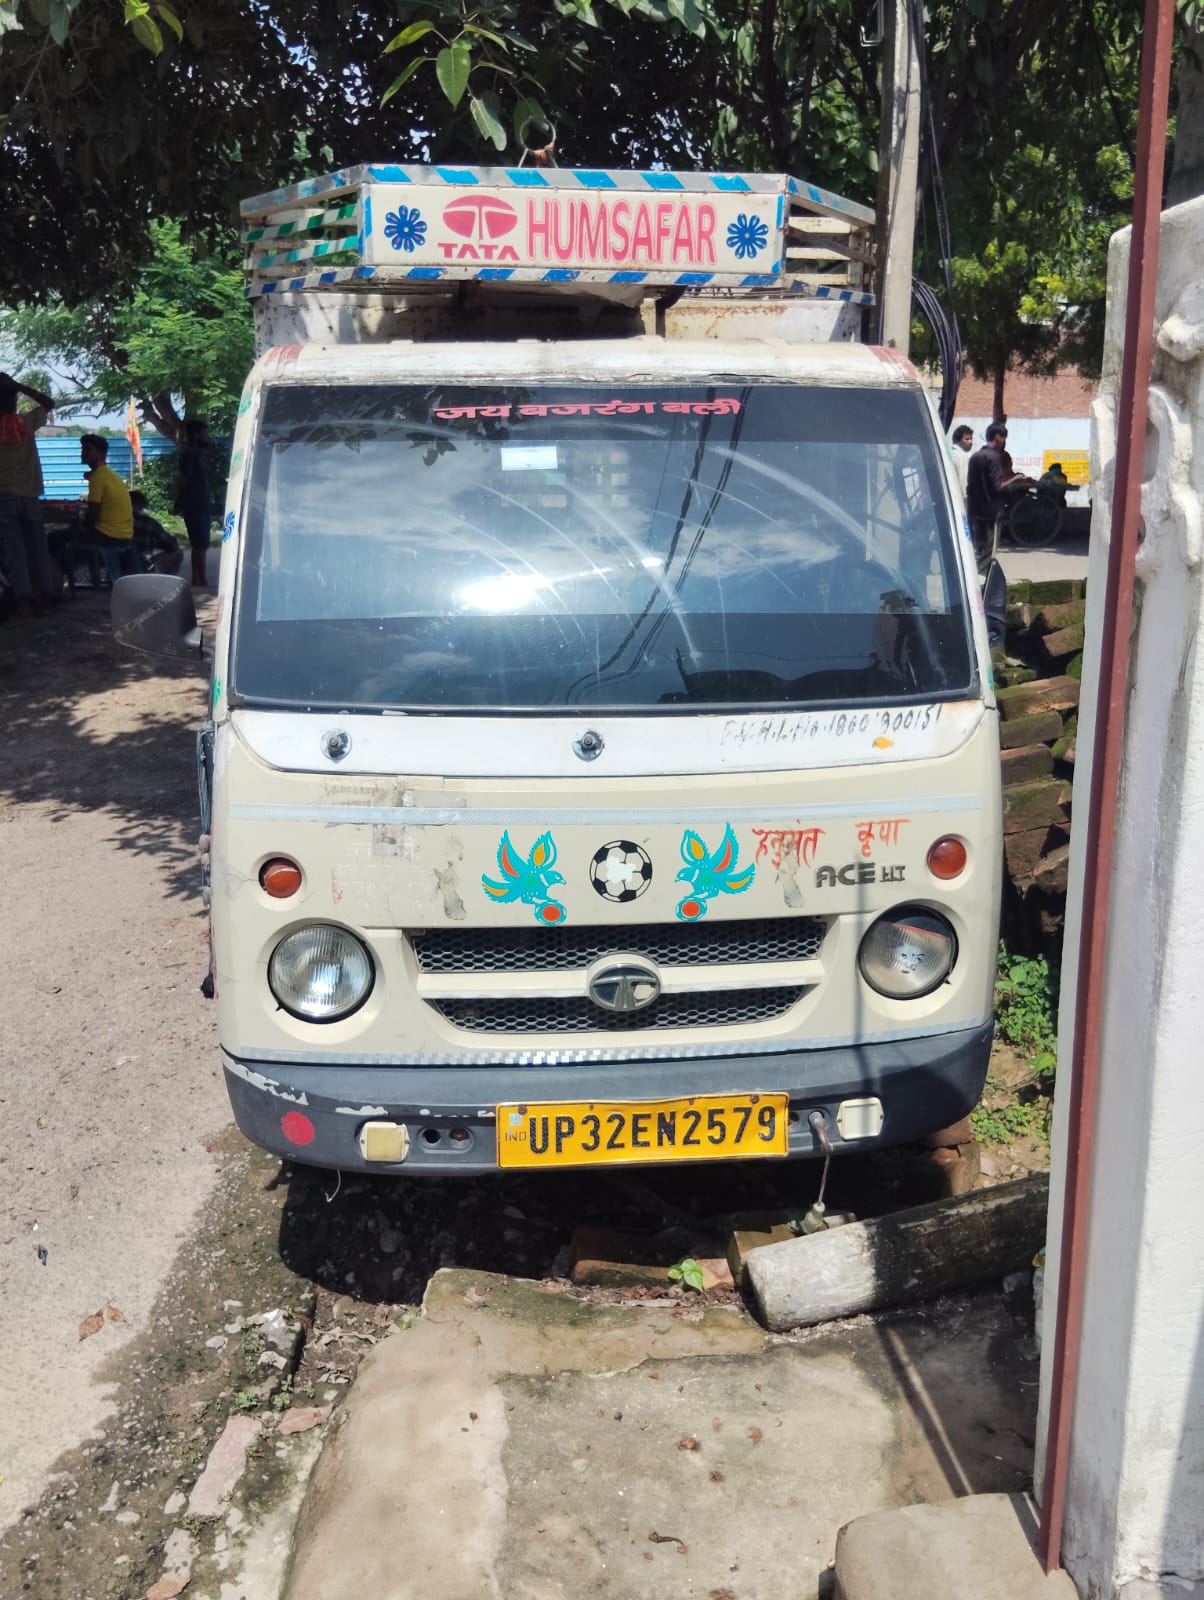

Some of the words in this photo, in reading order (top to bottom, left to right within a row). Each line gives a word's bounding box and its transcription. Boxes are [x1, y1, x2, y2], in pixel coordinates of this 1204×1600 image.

[526, 196, 718, 265] HUMSAFAR
[437, 242, 521, 262] TATA
[433, 404, 513, 420] जय
[519, 399, 655, 417] बजरंग
[662, 398, 742, 416] बली
[751, 819, 826, 869] हनुमंत
[816, 862, 876, 888] ACE
[529, 1106, 777, 1154] UP32EN2579
